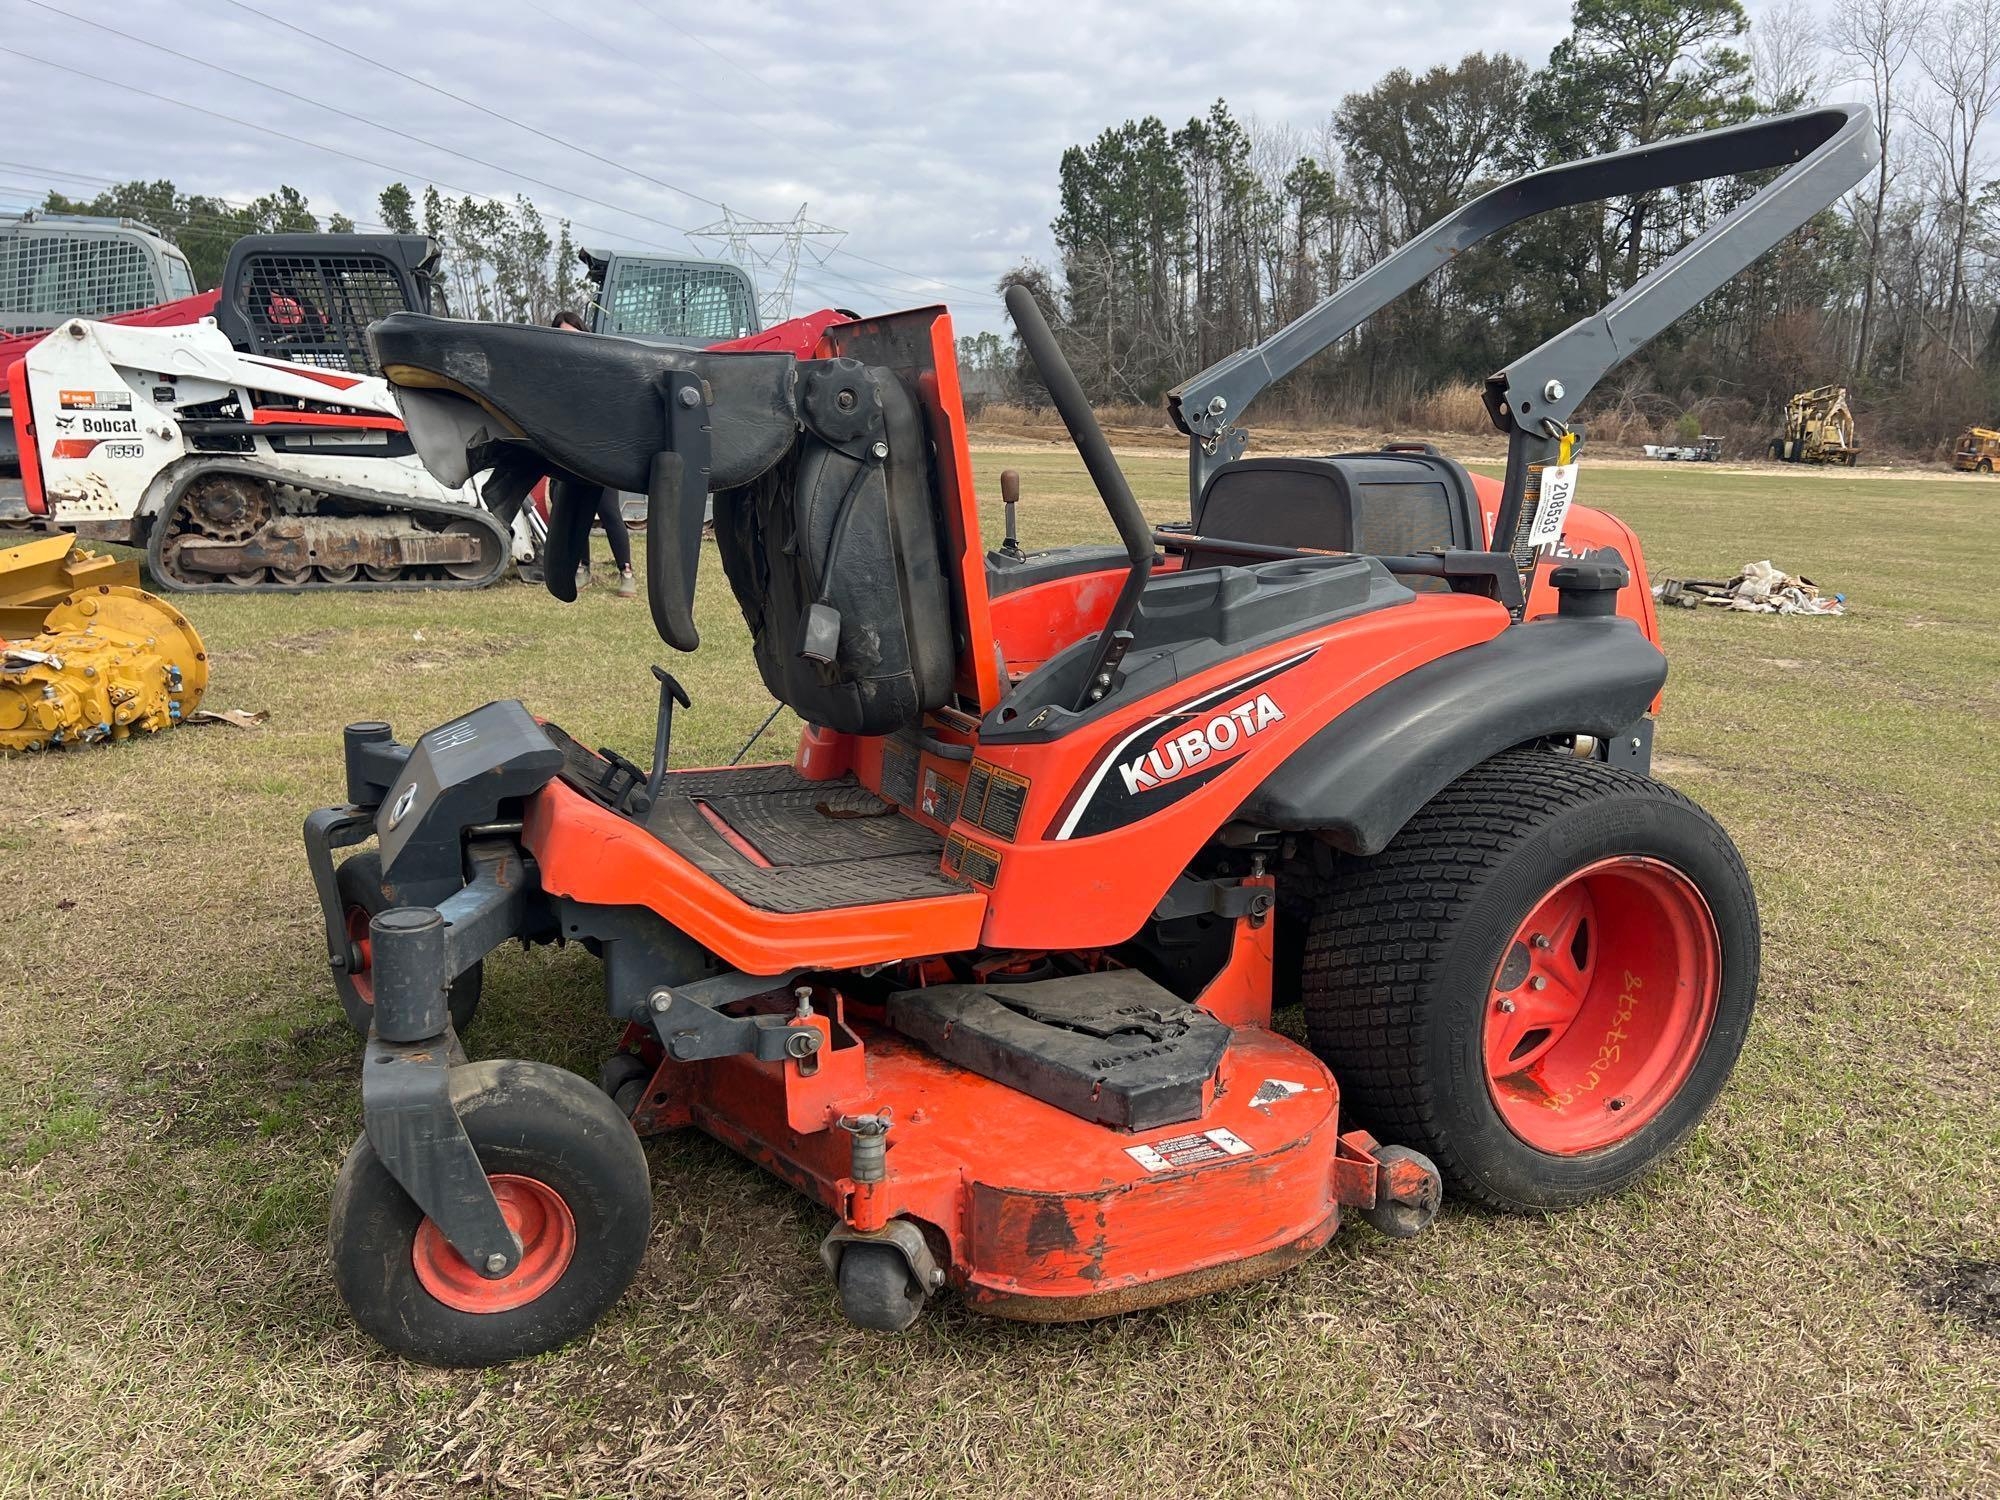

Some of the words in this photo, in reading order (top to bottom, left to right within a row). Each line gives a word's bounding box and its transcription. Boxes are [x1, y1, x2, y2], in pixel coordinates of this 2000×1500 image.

[82, 418, 137, 432] Bobcat
[105, 444, 144, 458] T550
[1542, 482, 1569, 534] 208533
[1118, 692, 1286, 796] KUBOTA
